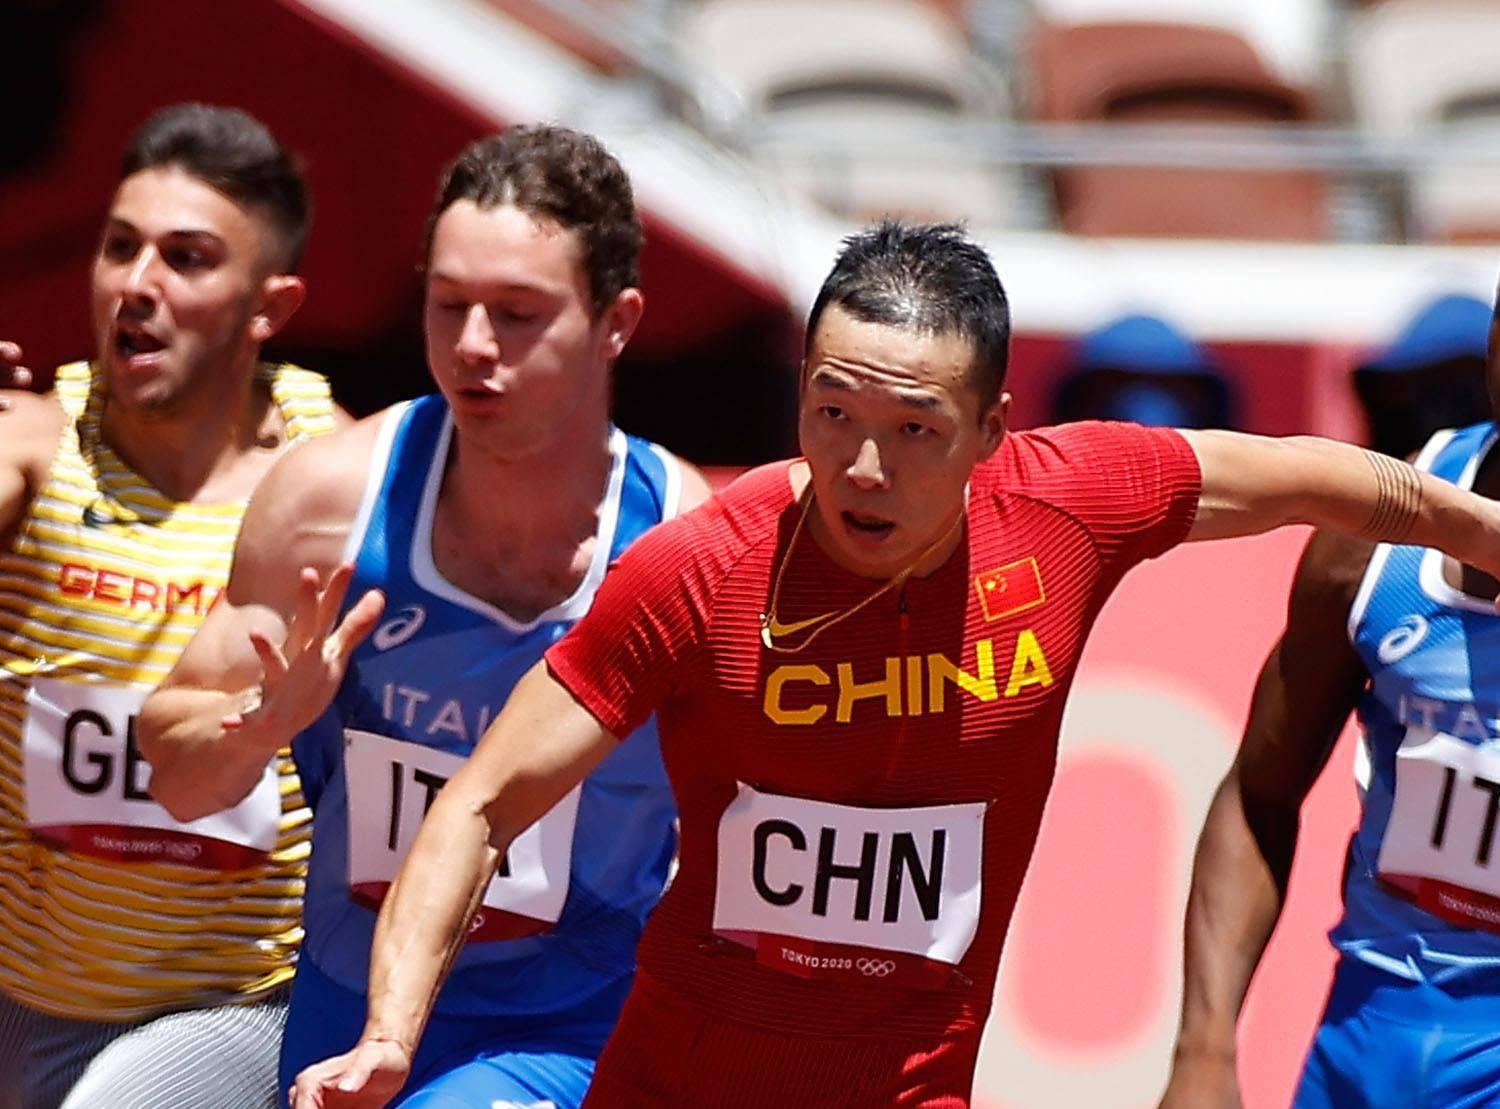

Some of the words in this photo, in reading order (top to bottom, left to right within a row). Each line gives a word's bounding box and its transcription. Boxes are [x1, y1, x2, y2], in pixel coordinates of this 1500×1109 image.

[763, 629, 1055, 725] CHINA
[751, 819, 948, 923] CHN
[781, 947, 820, 968] TOKYO
[821, 957, 853, 969] 2020
